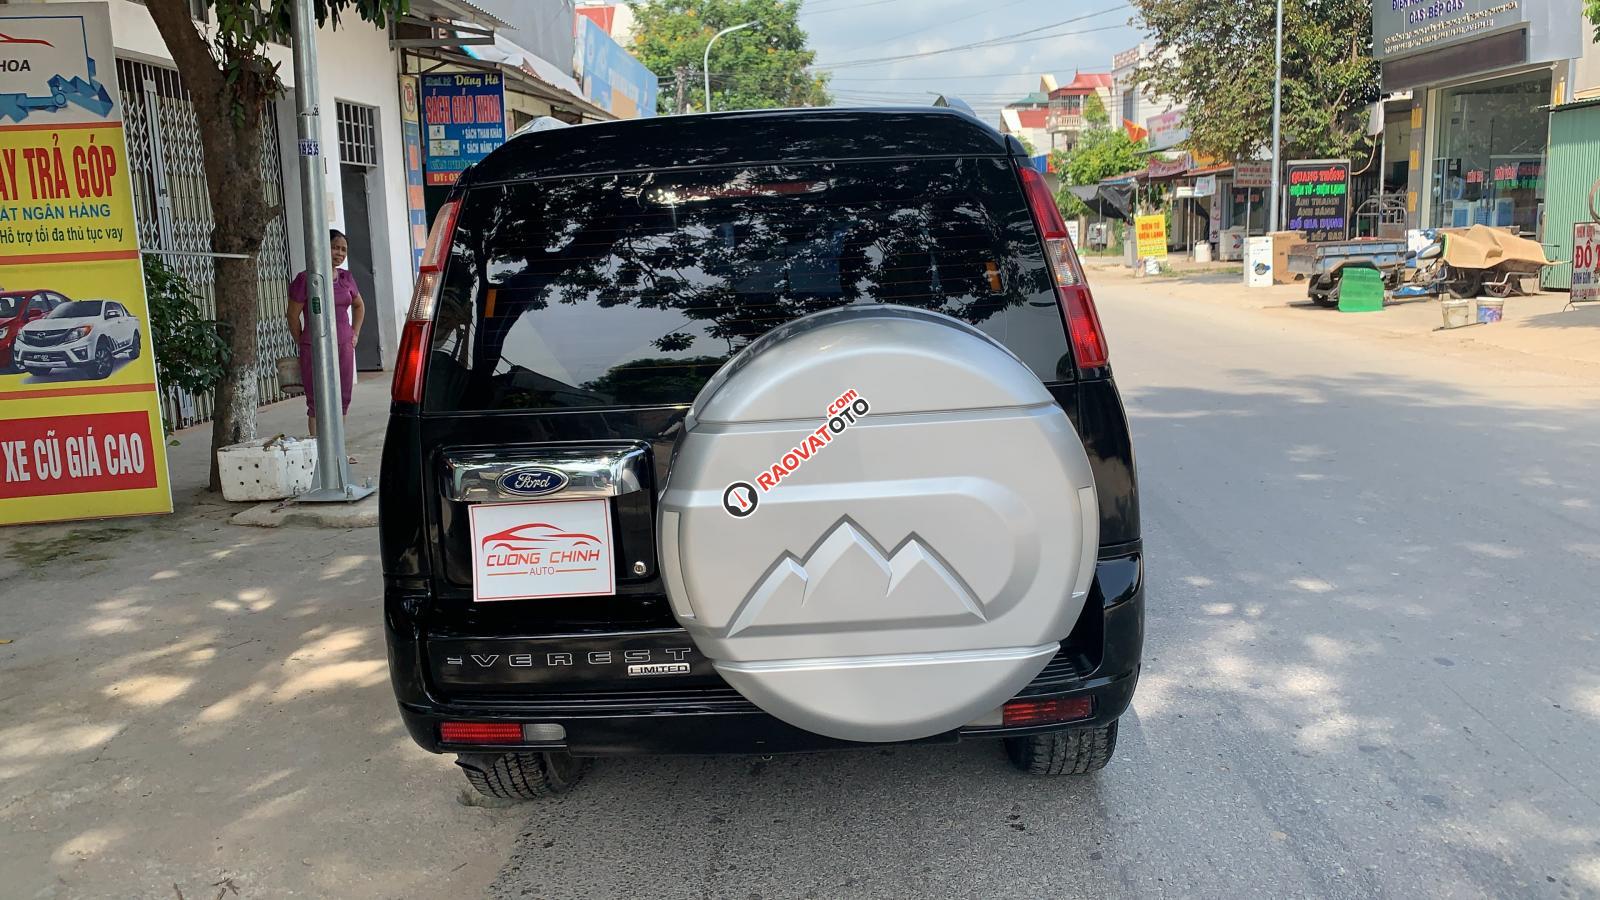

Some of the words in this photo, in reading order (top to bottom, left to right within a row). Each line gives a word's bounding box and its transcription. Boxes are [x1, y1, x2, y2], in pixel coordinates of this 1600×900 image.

[23, 133, 69, 200] TRẢ
[73, 134, 117, 199] GÓP
[22, 202, 64, 221] NGÂN
[69, 201, 111, 219] HÀNG
[17, 230, 33, 247] trợ
[52, 227, 65, 242] đa
[67, 226, 85, 242] thủ
[87, 226, 103, 244] tục
[105, 228, 124, 242] vay
[1, 440, 31, 482] XE
[34, 430, 62, 480] CŨ
[65, 427, 102, 478] GIÁ
[104, 433, 145, 475] CAO
[514, 473, 551, 489] Ford
[486, 552, 541, 567] CUONG
[549, 549, 600, 564] CHINH
[529, 566, 555, 576] AUTO
[630, 664, 688, 674] LIMITED
